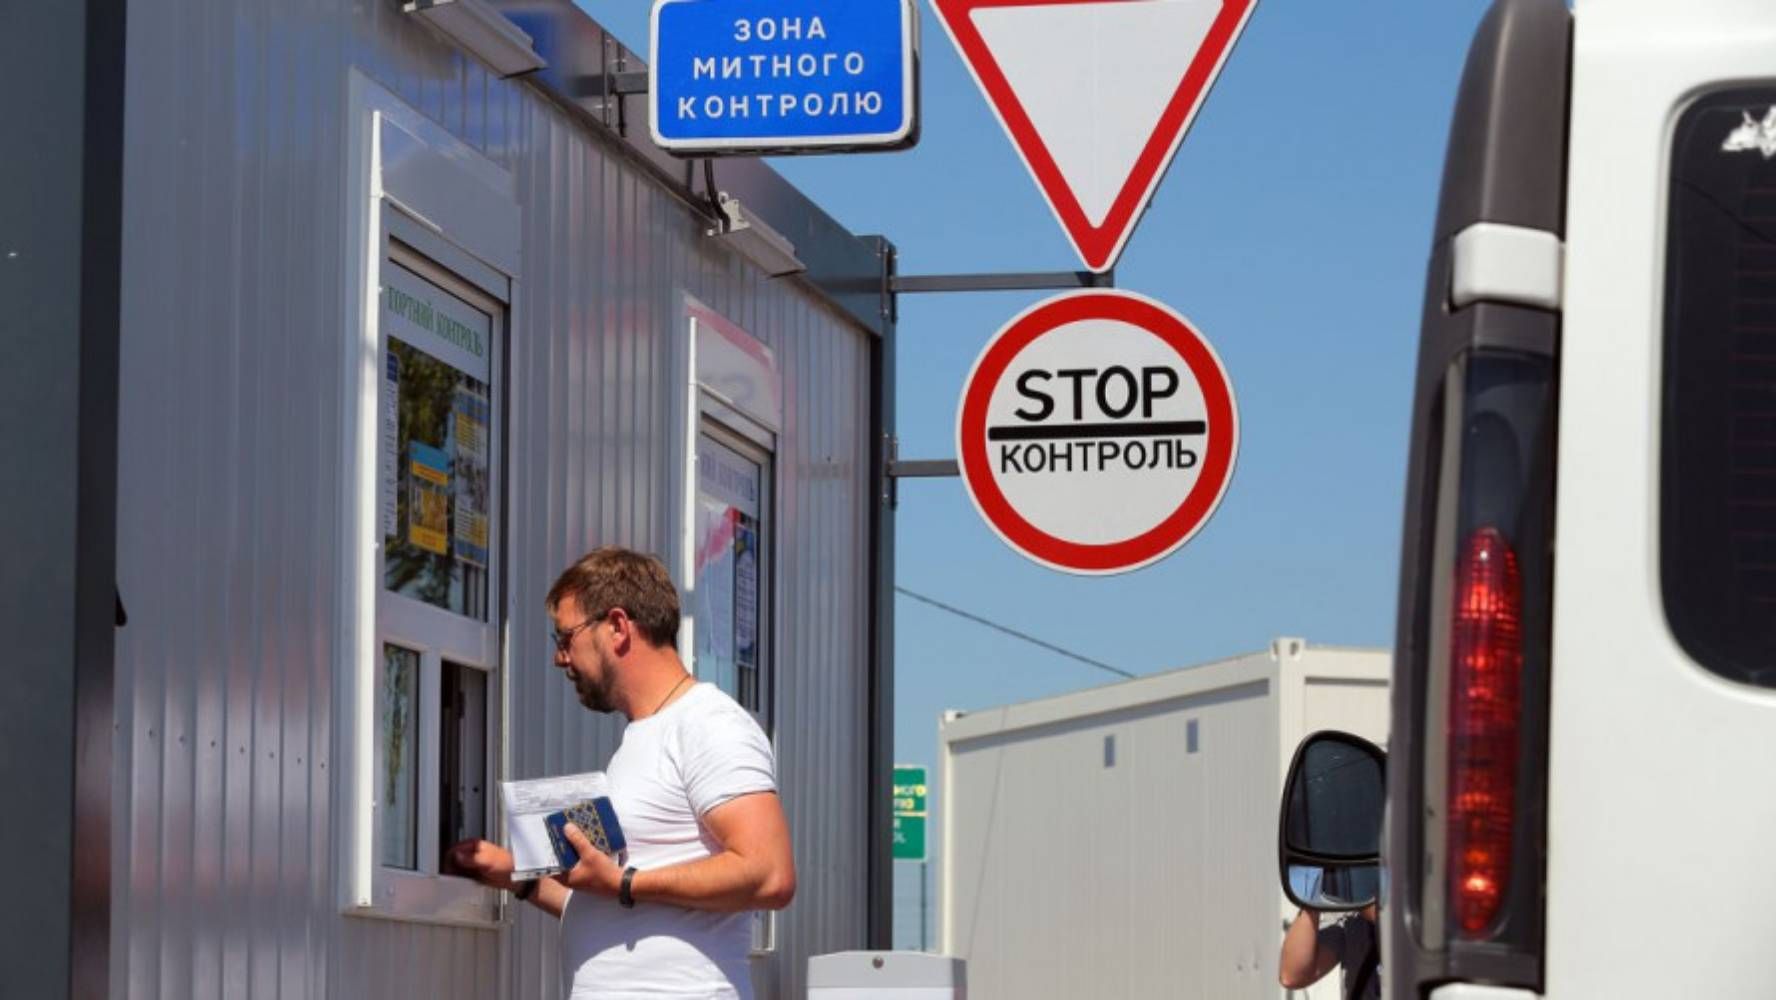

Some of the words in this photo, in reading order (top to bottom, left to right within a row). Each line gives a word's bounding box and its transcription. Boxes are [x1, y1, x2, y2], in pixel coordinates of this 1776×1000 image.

[734, 16, 826, 41] ЗОНА
[693, 52, 864, 80] МИТНОГО
[678, 91, 883, 119] КОНТРОЛЮ
[1014, 365, 1179, 422] STOP
[1000, 439, 1197, 474] КОНТРОЛЬ
